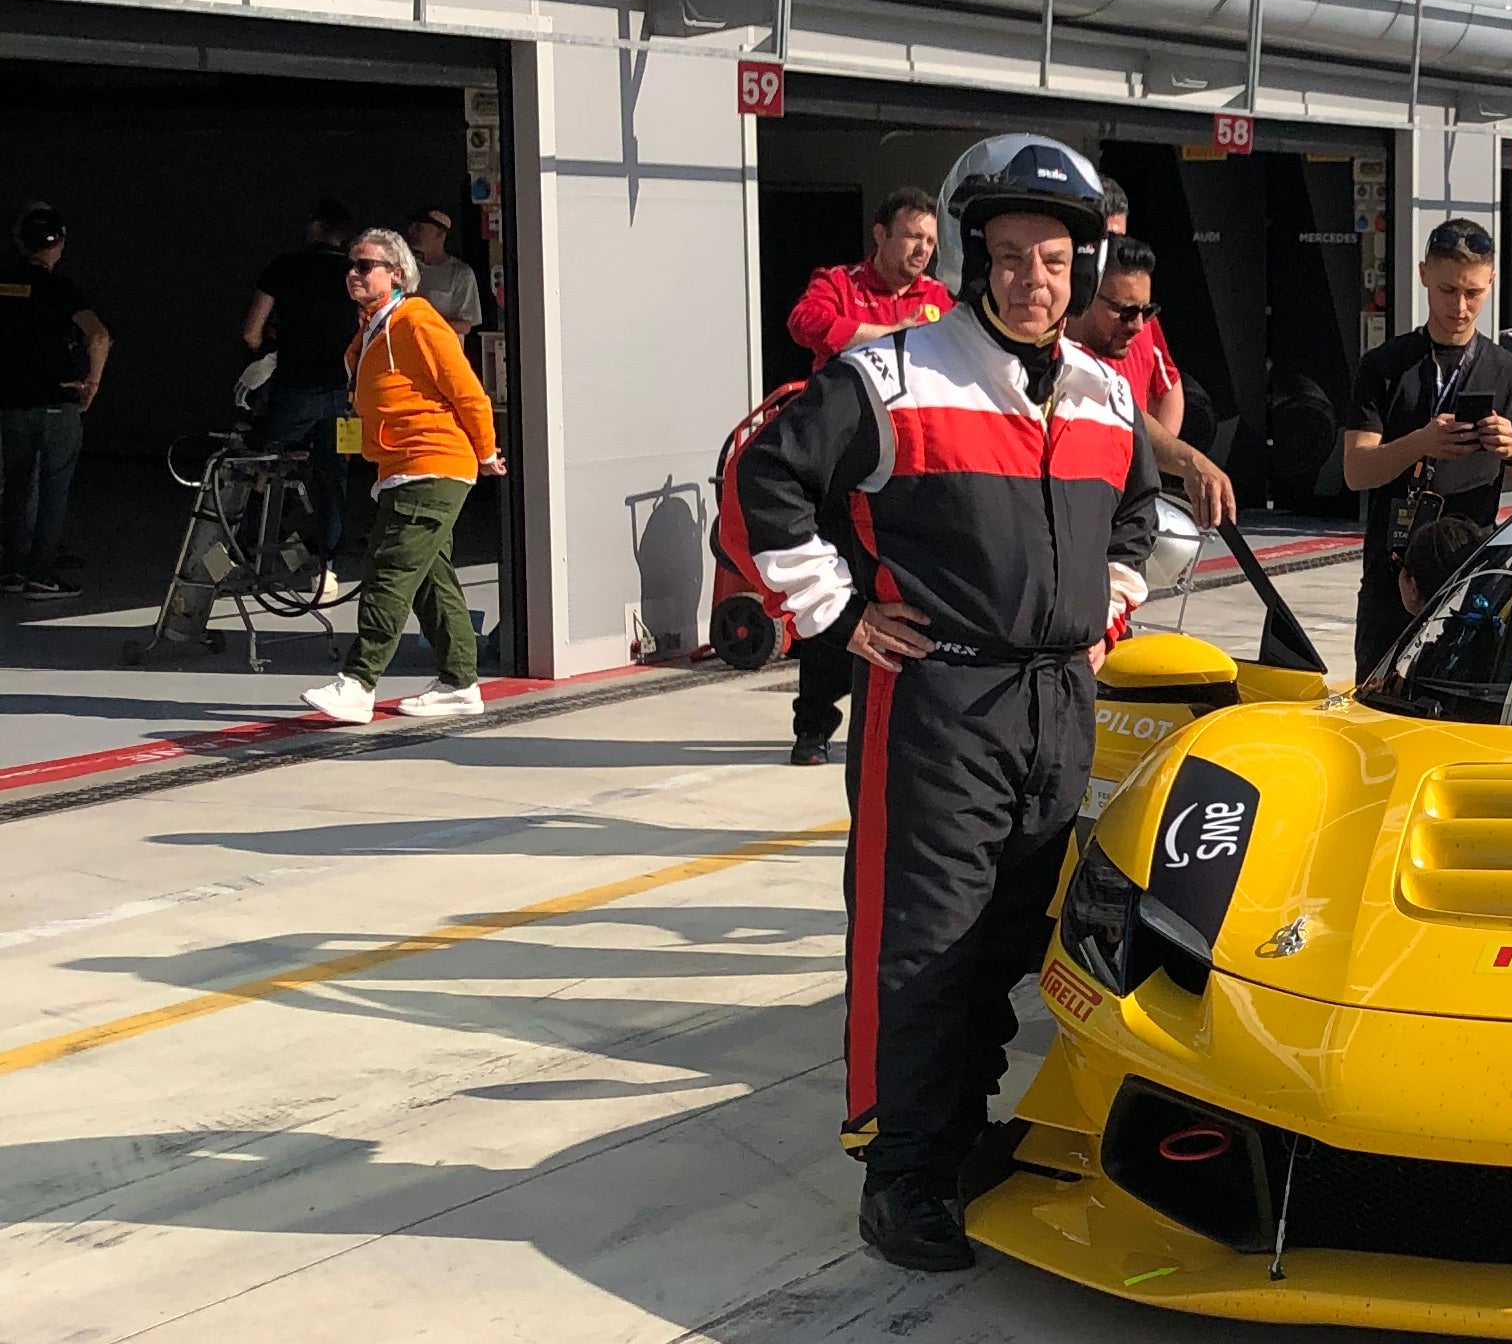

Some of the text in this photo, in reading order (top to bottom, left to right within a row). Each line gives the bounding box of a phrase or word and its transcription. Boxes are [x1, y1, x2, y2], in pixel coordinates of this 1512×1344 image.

[742, 71, 780, 106] 59
[1217, 118, 1249, 146] 58
[1192, 231, 1221, 242] AUDI
[1299, 232, 1358, 244] MERCEDES
[1196, 802, 1246, 860] aws
[1040, 958, 1104, 1023] PIRELLI
